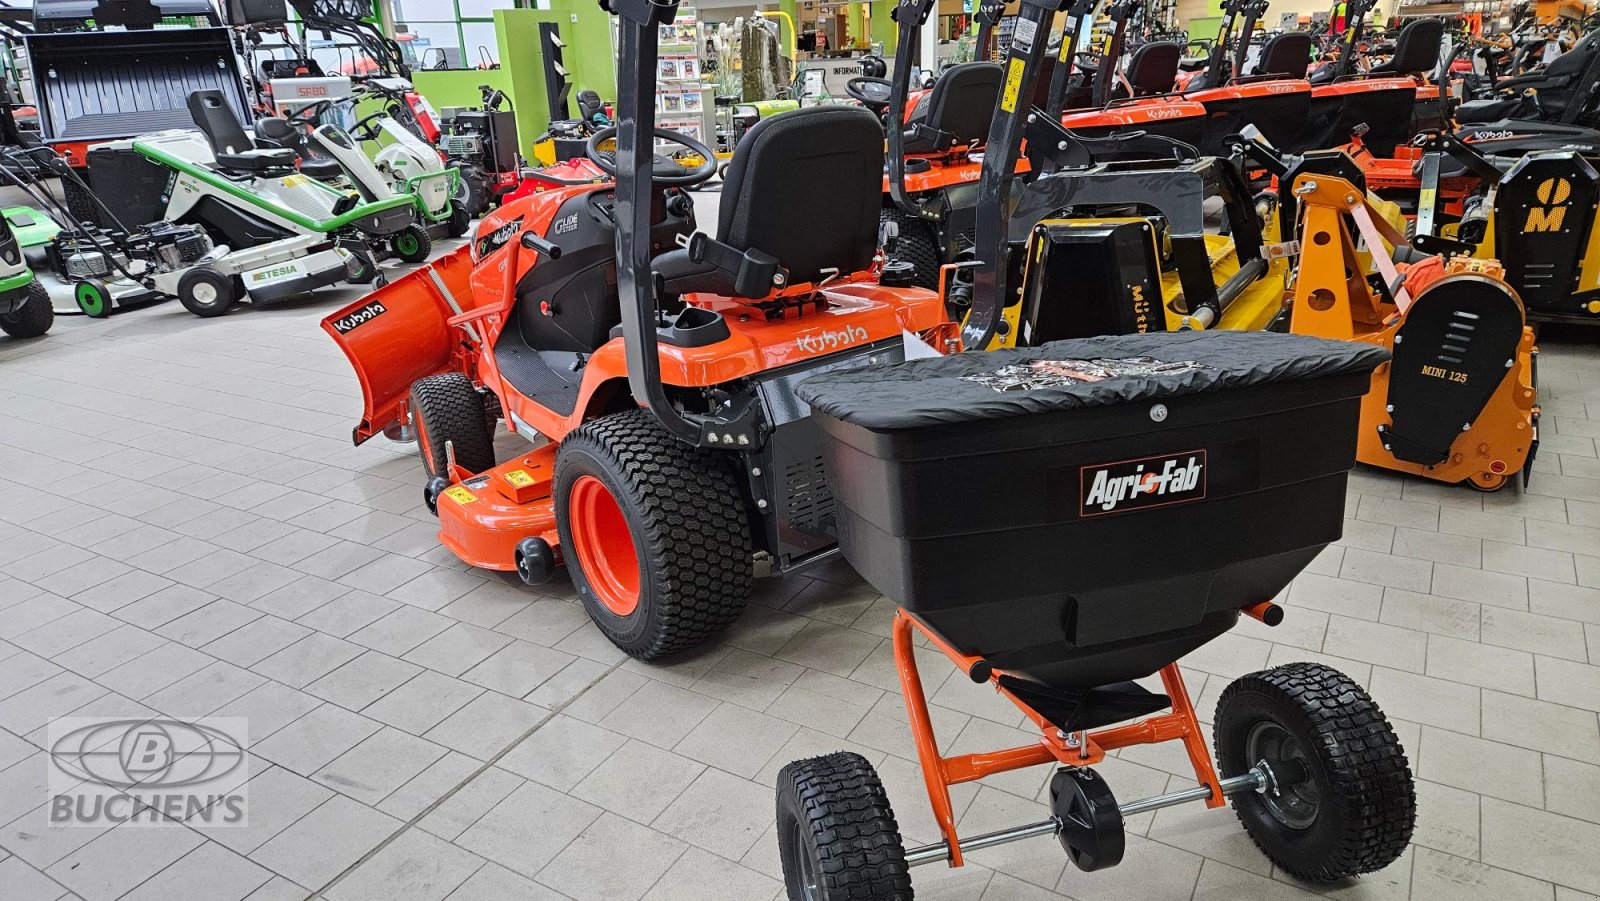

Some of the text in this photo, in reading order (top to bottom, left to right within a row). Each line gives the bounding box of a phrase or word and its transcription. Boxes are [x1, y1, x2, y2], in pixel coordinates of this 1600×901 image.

[1146, 108, 1183, 119] Kubota
[1475, 129, 1514, 139] Kubota
[554, 212, 579, 235] GLIDE
[562, 222, 579, 233] STEER
[492, 221, 519, 245] Kubota
[258, 264, 298, 281] ETESIA
[333, 303, 386, 331] Kubota
[796, 324, 869, 354] Kubota
[1421, 365, 1468, 383] MINI 125
